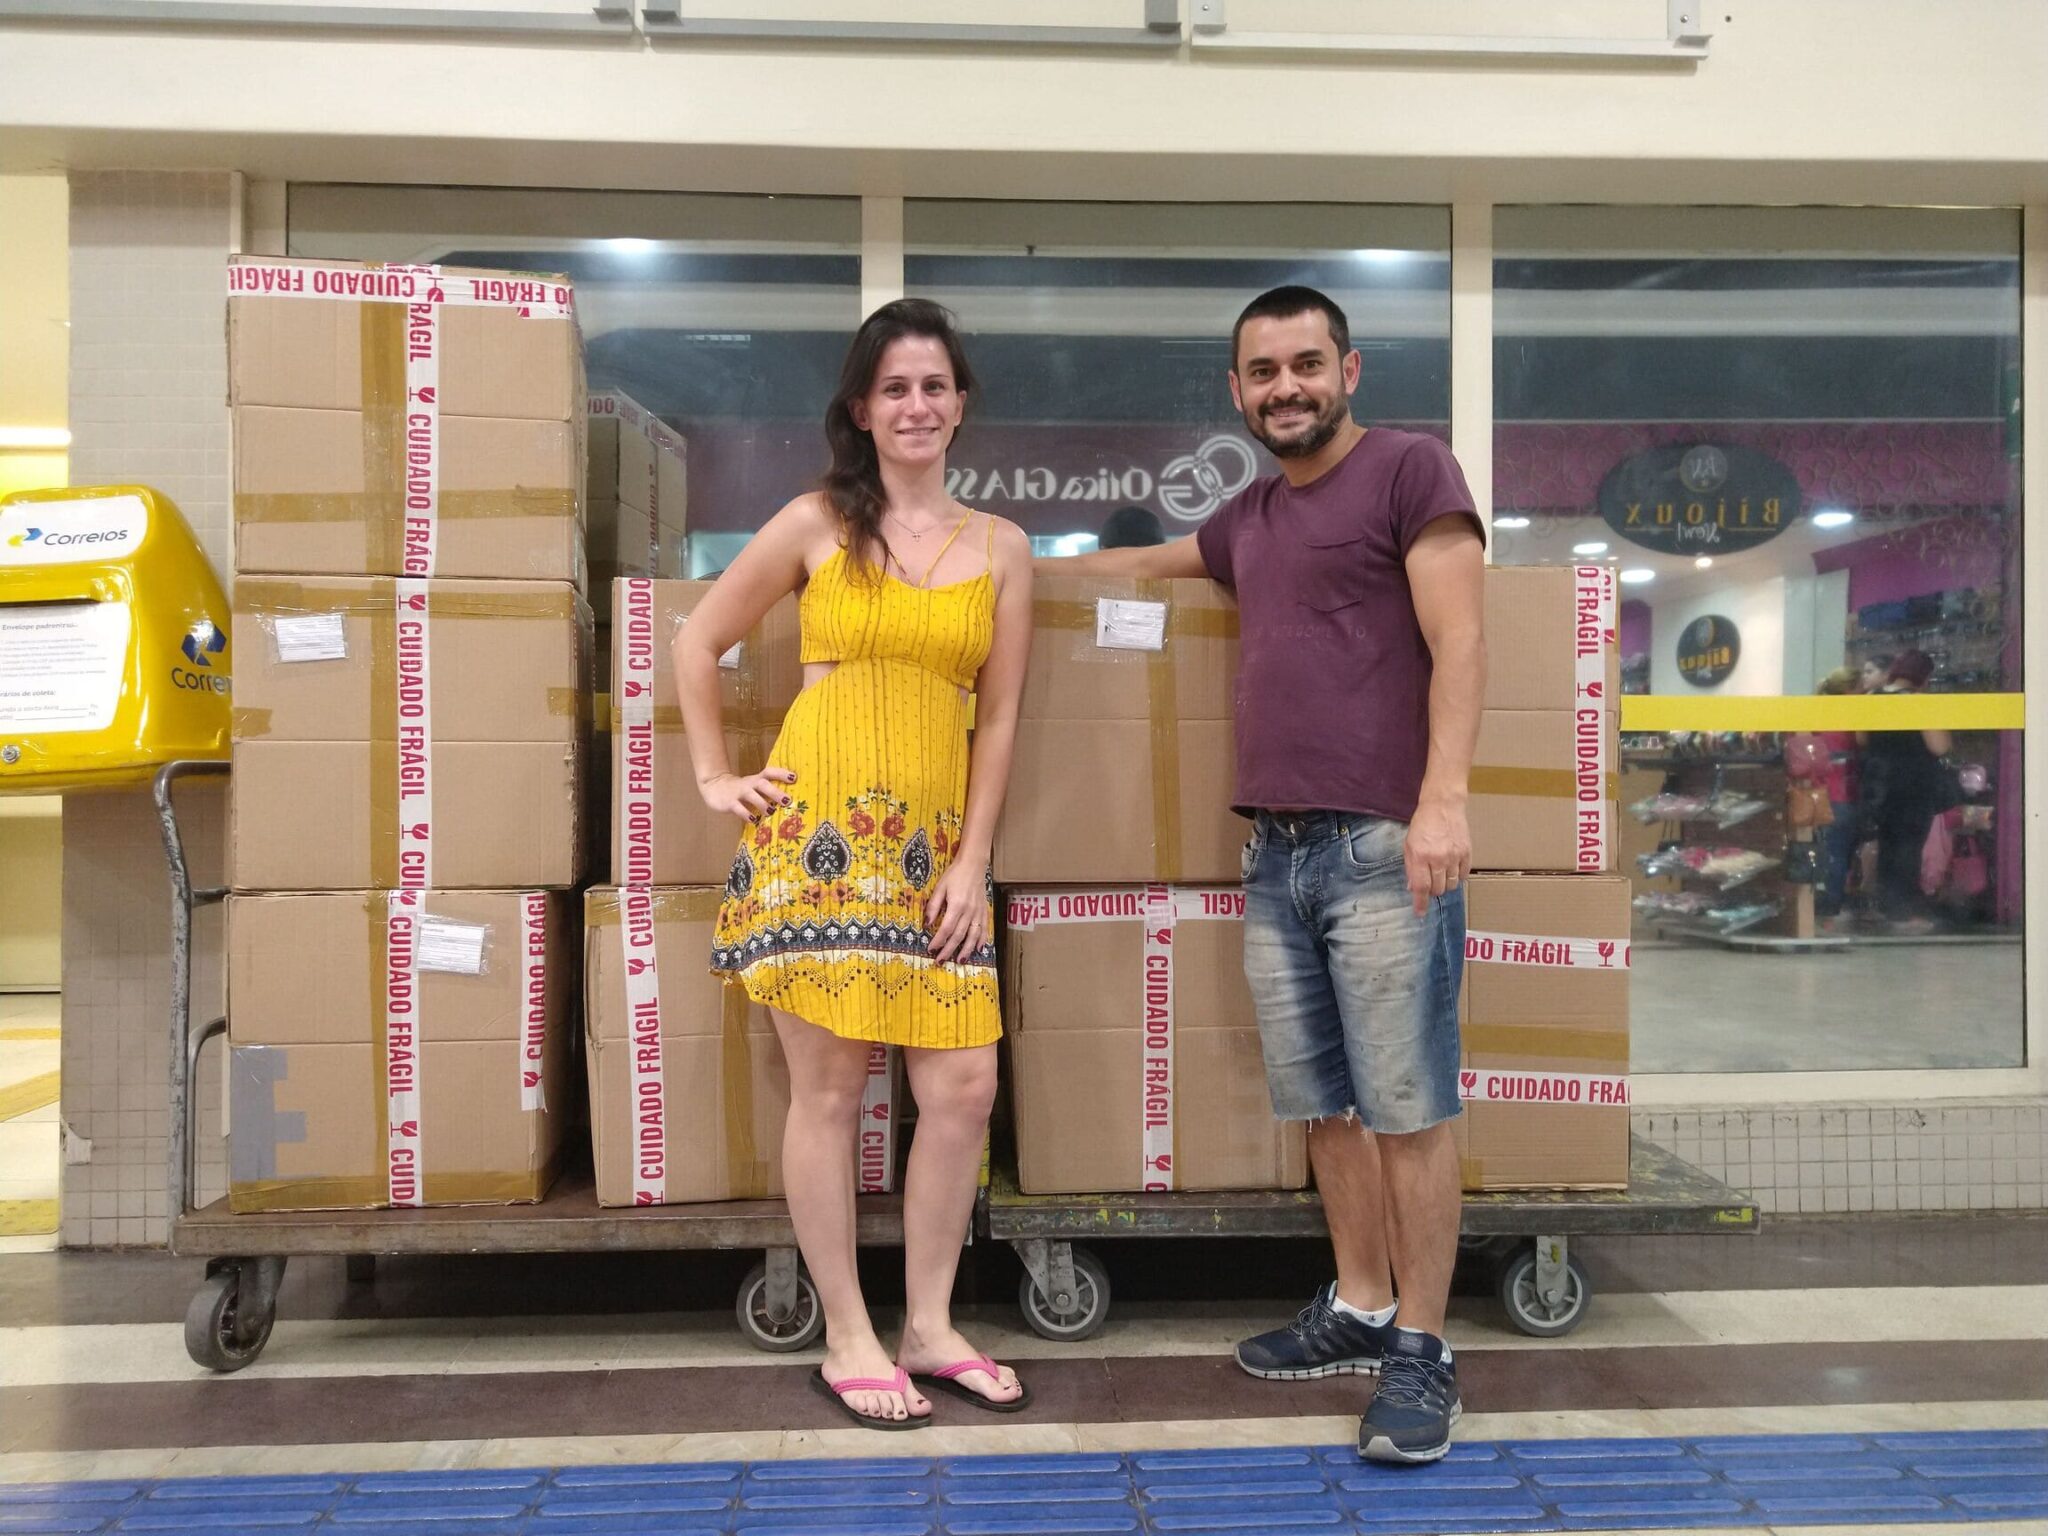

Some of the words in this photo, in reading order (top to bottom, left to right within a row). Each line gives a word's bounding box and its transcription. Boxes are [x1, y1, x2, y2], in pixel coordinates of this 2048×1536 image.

[313, 274, 416, 298] CUIDADO
[470, 278, 546, 305] FRÁGIL
[408, 303, 435, 362] RÁGIL
[407, 413, 432, 510] CUIDADO
[44, 529, 129, 547] Correios
[627, 577, 653, 671] CUIDADO
[1577, 586, 1602, 658] FRÁGIL
[399, 621, 425, 719] CUIDADO
[400, 725, 428, 801] FRÁGIL
[626, 720, 654, 795] FRÁGIL
[1576, 708, 1600, 803] CUIDADO
[1577, 810, 1603, 871] FRÁGI
[389, 915, 413, 1015] CUIDADO
[1501, 939, 1575, 966] FRÁGIL
[526, 963, 547, 1061] CUIDADO
[632, 996, 662, 1074] FRÁGIL
[1145, 954, 1169, 1050] CUIDADO
[388, 1021, 416, 1098] FRÁGIL
[1145, 1057, 1172, 1131] FRÁGIL
[1487, 1076, 1581, 1102] CUIDADO
[1588, 1078, 1630, 1104] FRÁ
[638, 1081, 664, 1181] CUIDADO
